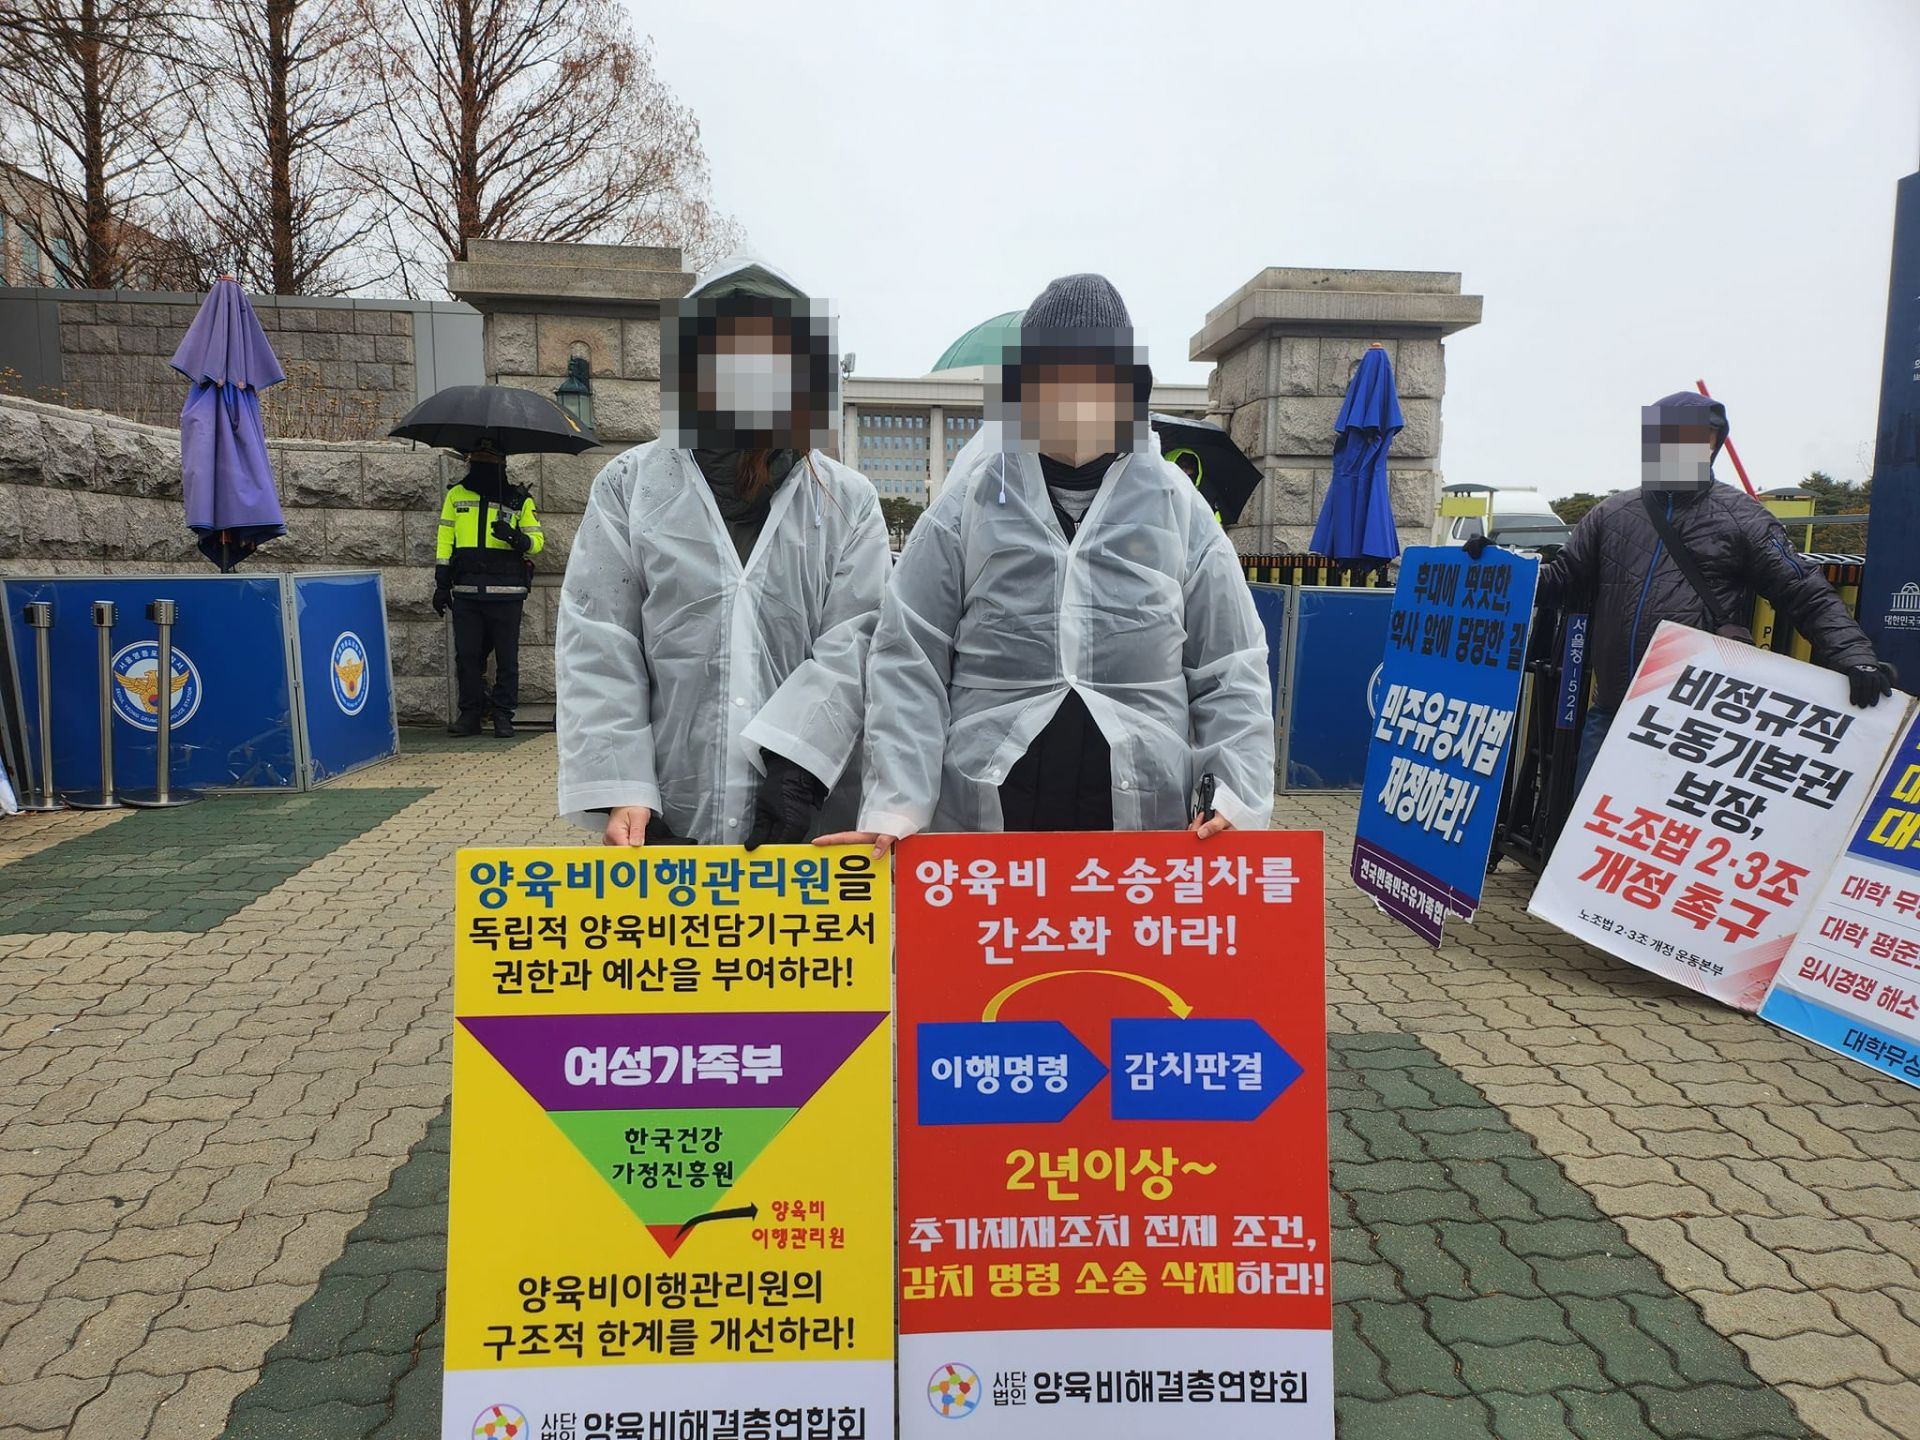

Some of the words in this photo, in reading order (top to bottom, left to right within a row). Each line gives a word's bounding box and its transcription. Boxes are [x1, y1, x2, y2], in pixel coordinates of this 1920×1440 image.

[1414, 562, 1461, 608] 후대에
[1462, 564, 1512, 616] 떳떳한,
[1391, 610, 1421, 652] 역사
[1421, 614, 1454, 658] 앞에
[1455, 617, 1504, 667] 당당한
[1507, 624, 1527, 671] 길
[1884, 615, 1920, 627] 대한민국
[1375, 683, 1514, 776] 민주유공자법
[1667, 665, 1856, 754] 비정규직
[1628, 705, 1854, 810] 노동기본권
[1378, 756, 1480, 844] 제정하라!
[1665, 770, 1769, 841] 보장,
[1583, 794, 1703, 867] 노조법
[1867, 807, 1920, 851] 대
[470, 854, 876, 909] 양육비이행관리원을
[916, 858, 1046, 907] 양육비
[1070, 856, 1300, 904] 소송절차를
[1578, 845, 1678, 911] 개정
[1671, 882, 1772, 944] 촉구
[1840, 875, 1892, 908] 대학
[1893, 889, 1920, 920] 무
[469, 915, 568, 951] 독립적
[580, 912, 875, 949] 양육비전담기구로서
[977, 915, 1112, 965] 간소화
[1133, 915, 1237, 956] 하라!
[1578, 909, 1614, 932] 노조법
[1650, 939, 1676, 957] 개정
[1675, 949, 1725, 977] 운동본부
[1819, 915, 1869, 949] 대학
[1870, 932, 1920, 971] 평준
[492, 958, 592, 994] 권한과
[602, 958, 701, 991] 예산을
[712, 955, 854, 991] 부여하라!
[1798, 956, 1879, 1003] 입시경쟁
[1876, 985, 1920, 1021] 해소
[564, 1044, 783, 1087] 여성가족부
[931, 1053, 1069, 1095] 이행명령
[1125, 1051, 1263, 1092] 감치판결
[624, 1127, 723, 1155] 한국건강
[612, 1160, 734, 1189] 가정진흥원
[1005, 1147, 1217, 1201] 2년이상~
[771, 1200, 825, 1222] 양육비
[908, 1213, 1130, 1252] 추가제재조치
[1144, 1214, 1217, 1248] 전제
[1232, 1215, 1317, 1252] 조건,
[752, 1226, 845, 1249] 이행관리원
[518, 1270, 823, 1313] 양육비이행관리원의
[902, 1264, 973, 1300] 감치
[989, 1262, 1060, 1297] 명령
[1074, 1261, 1147, 1295] 소송
[1161, 1260, 1325, 1296] 삭제하라!
[483, 1322, 584, 1361] 구조적
[597, 1319, 698, 1357] 한계를
[710, 1316, 855, 1353] 개선하라!
[993, 1371, 1027, 1388] 사단
[993, 1389, 1027, 1406] 법인
[1034, 1369, 1308, 1404] 양육비해결총연합회
[541, 1411, 577, 1431] 사단
[583, 1406, 866, 1440] 양육비해결총연합회
